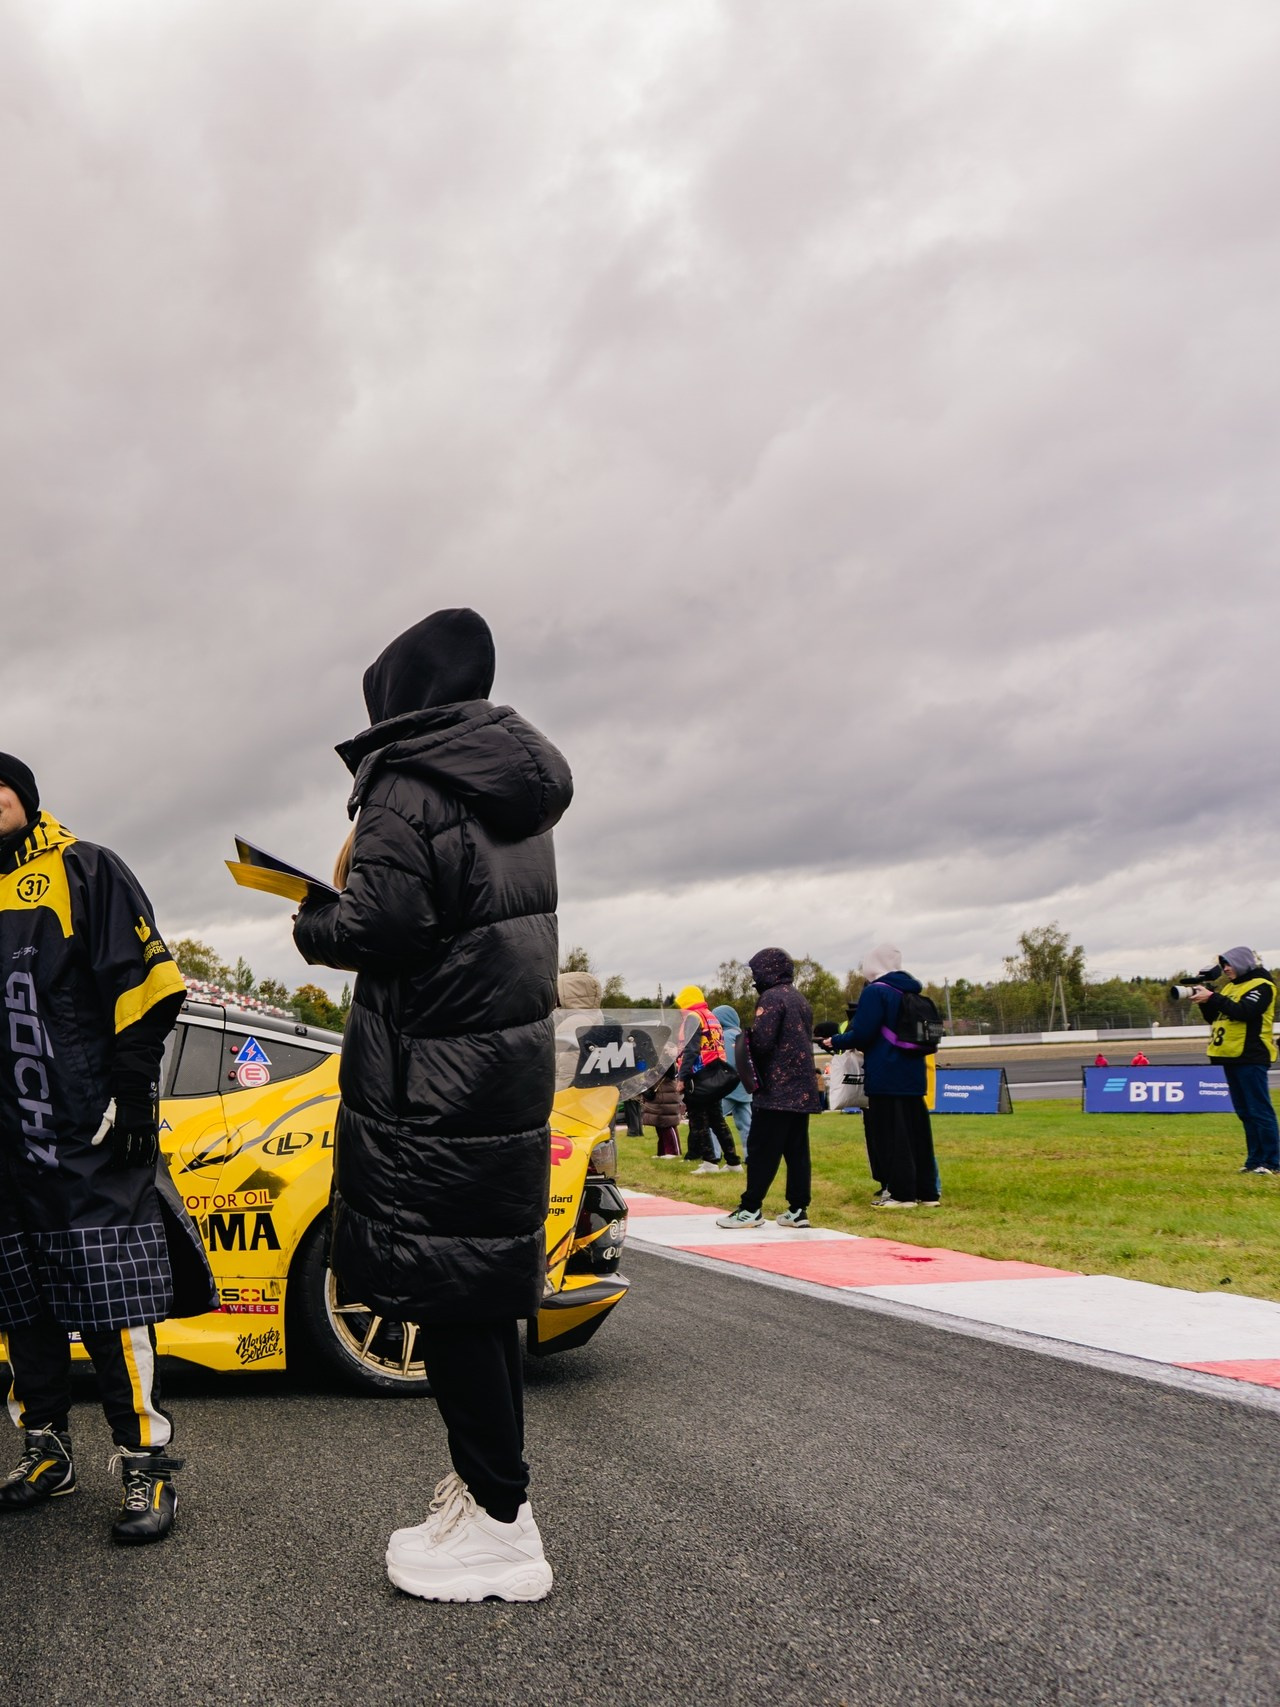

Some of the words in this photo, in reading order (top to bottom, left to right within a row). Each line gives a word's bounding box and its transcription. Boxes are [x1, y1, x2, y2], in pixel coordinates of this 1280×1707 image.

[24, 879, 43, 897] 31
[245, 1068, 262, 1081] E
[1129, 1081, 1185, 1102] ВТБ
[243, 1190, 273, 1205] OIL
[229, 1304, 276, 1313] WHEELS
